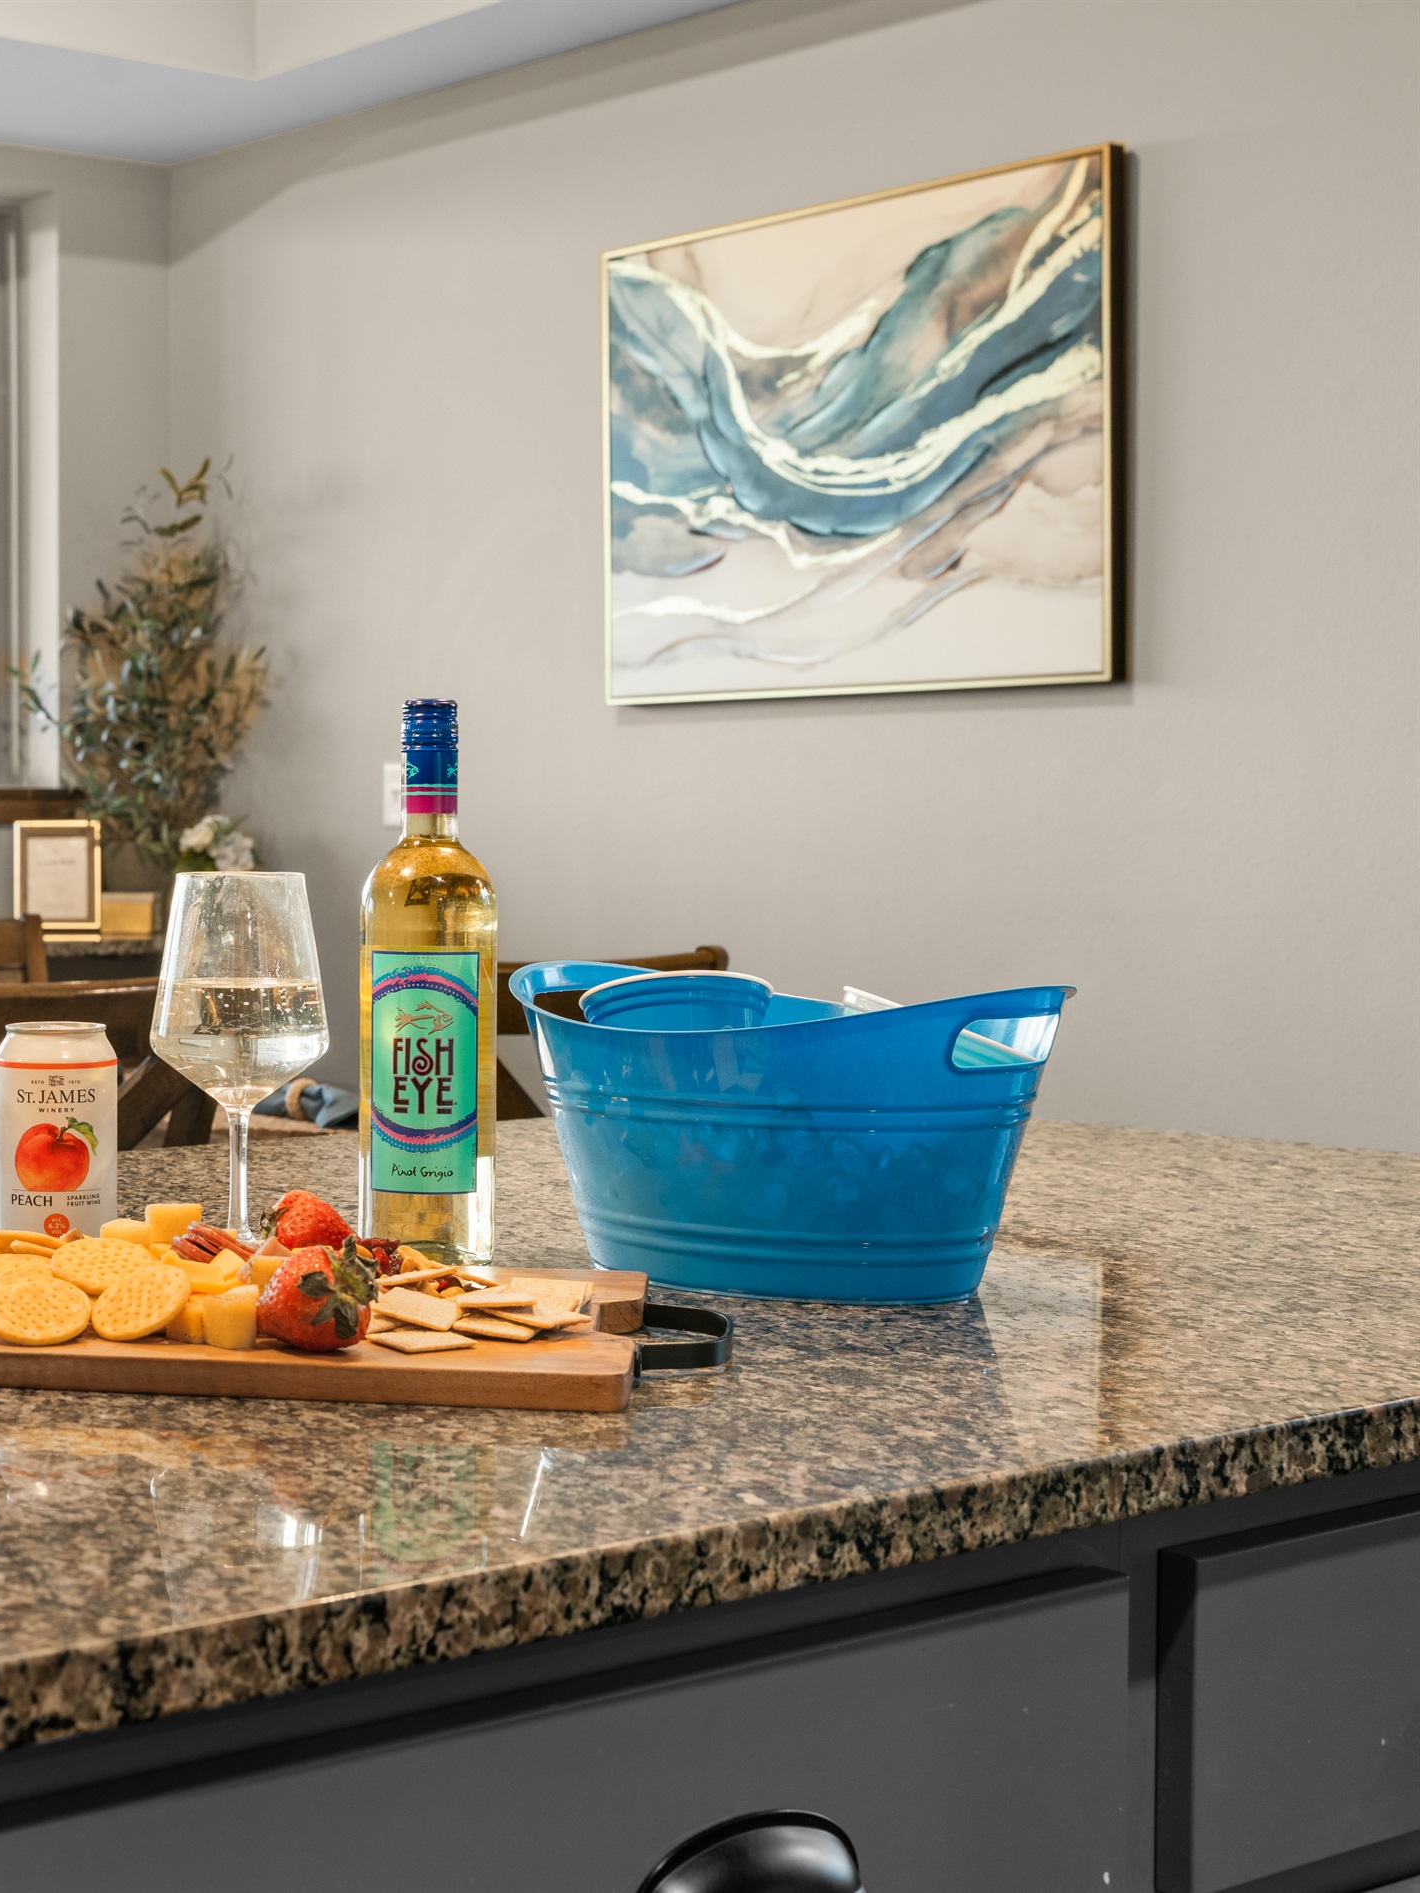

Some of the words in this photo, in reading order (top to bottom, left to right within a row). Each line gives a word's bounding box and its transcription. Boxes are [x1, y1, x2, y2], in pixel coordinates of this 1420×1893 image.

[393, 1037, 454, 1076] FISH
[39, 1089, 96, 1104] JAMES
[393, 1076, 454, 1114] EYE
[391, 1163, 416, 1176] Pinot
[420, 1166, 453, 1182] Grigio
[11, 1194, 53, 1207] PEACH
